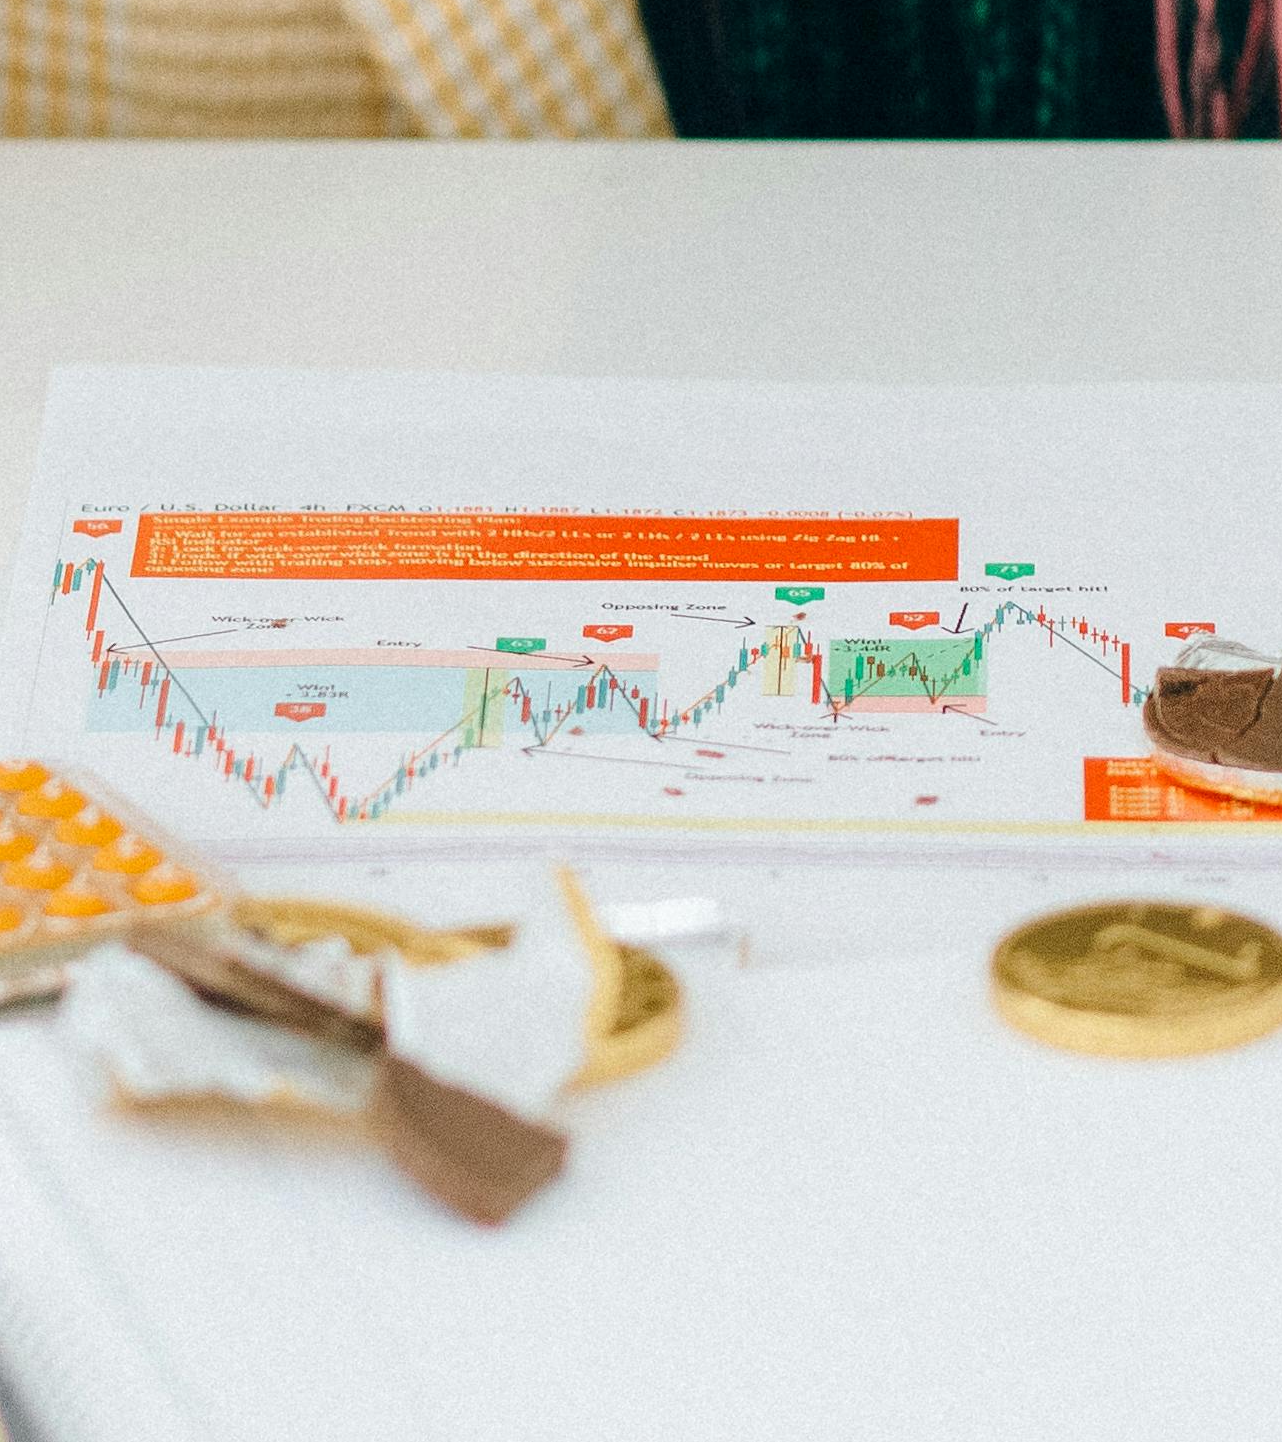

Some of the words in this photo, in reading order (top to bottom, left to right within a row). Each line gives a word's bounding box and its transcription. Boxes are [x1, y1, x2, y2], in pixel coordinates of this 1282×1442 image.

[82, 503, 130, 513] Euro
[160, 503, 203, 512] U.S.
[215, 503, 277, 512] Dollar
[346, 504, 406, 512] FXCM
[154, 516, 212, 524] Simple
[218, 516, 293, 524] Example
[301, 516, 363, 525] Trading
[369, 516, 471, 525] Backtesting
[174, 530, 214, 538] Wait
[220, 530, 244, 538] for
[278, 529, 379, 537] established
[387, 529, 436, 537] Trend
[442, 529, 481, 537] with
[741, 534, 786, 543] using
[183, 538, 262, 546] Indicator
[394, 543, 482, 551] formation
[513, 551, 595, 559] direction
[659, 553, 709, 561] trend
[280, 558, 343, 567] trailing
[398, 558, 464, 566] moving
[527, 559, 622, 567] successive
[627, 560, 696, 568] impulse
[790, 562, 843, 571] target
[850, 561, 886, 570] 80%
[890, 561, 908, 570] of
[959, 585, 990, 593] 80%
[997, 585, 1014, 593] of
[1021, 585, 1073, 594] target
[601, 602, 679, 612] Opposing
[685, 603, 727, 611] Zone
[376, 639, 423, 648] Entry
[979, 729, 1027, 737] Entry
